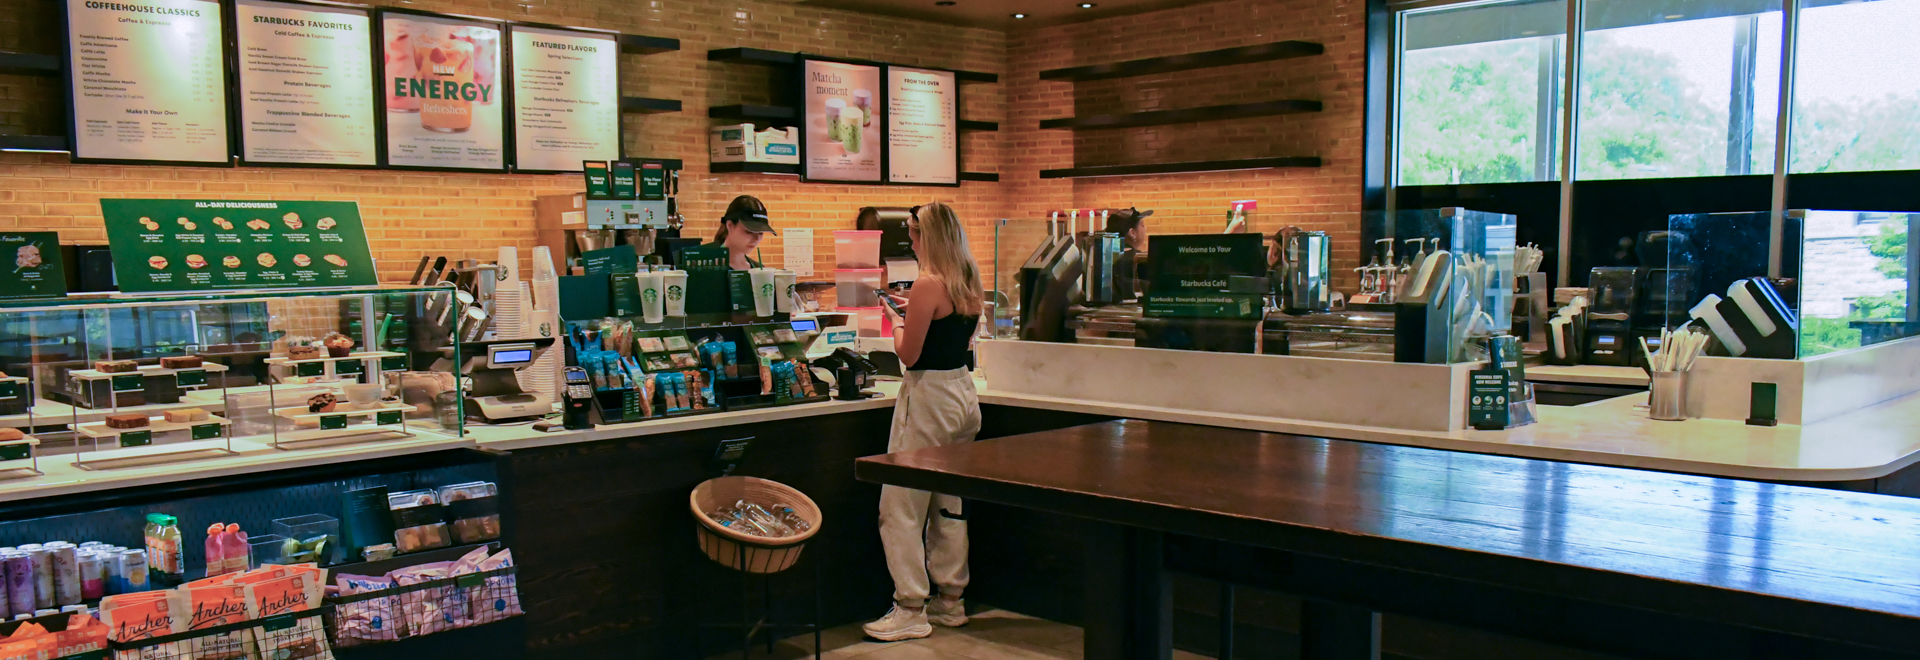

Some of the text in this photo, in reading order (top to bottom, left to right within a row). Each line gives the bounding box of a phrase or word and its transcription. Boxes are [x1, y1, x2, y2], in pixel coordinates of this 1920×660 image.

[85, 1, 200, 17] COFFEEHOUSE CLASSICS
[253, 15, 353, 31] STARBUCKS FAVORITES
[532, 41, 597, 53] FEATURED FLAVORS
[432, 65, 455, 74] NEW
[812, 72, 842, 84] Matcha
[395, 77, 492, 102] ENERGY
[816, 87, 848, 97] moment
[423, 103, 468, 115] Refreshers
[1178, 246, 1208, 254] Welcome
[257, 590, 309, 619] Archer
[188, 598, 248, 626] Archer
[115, 614, 174, 642] Archer
